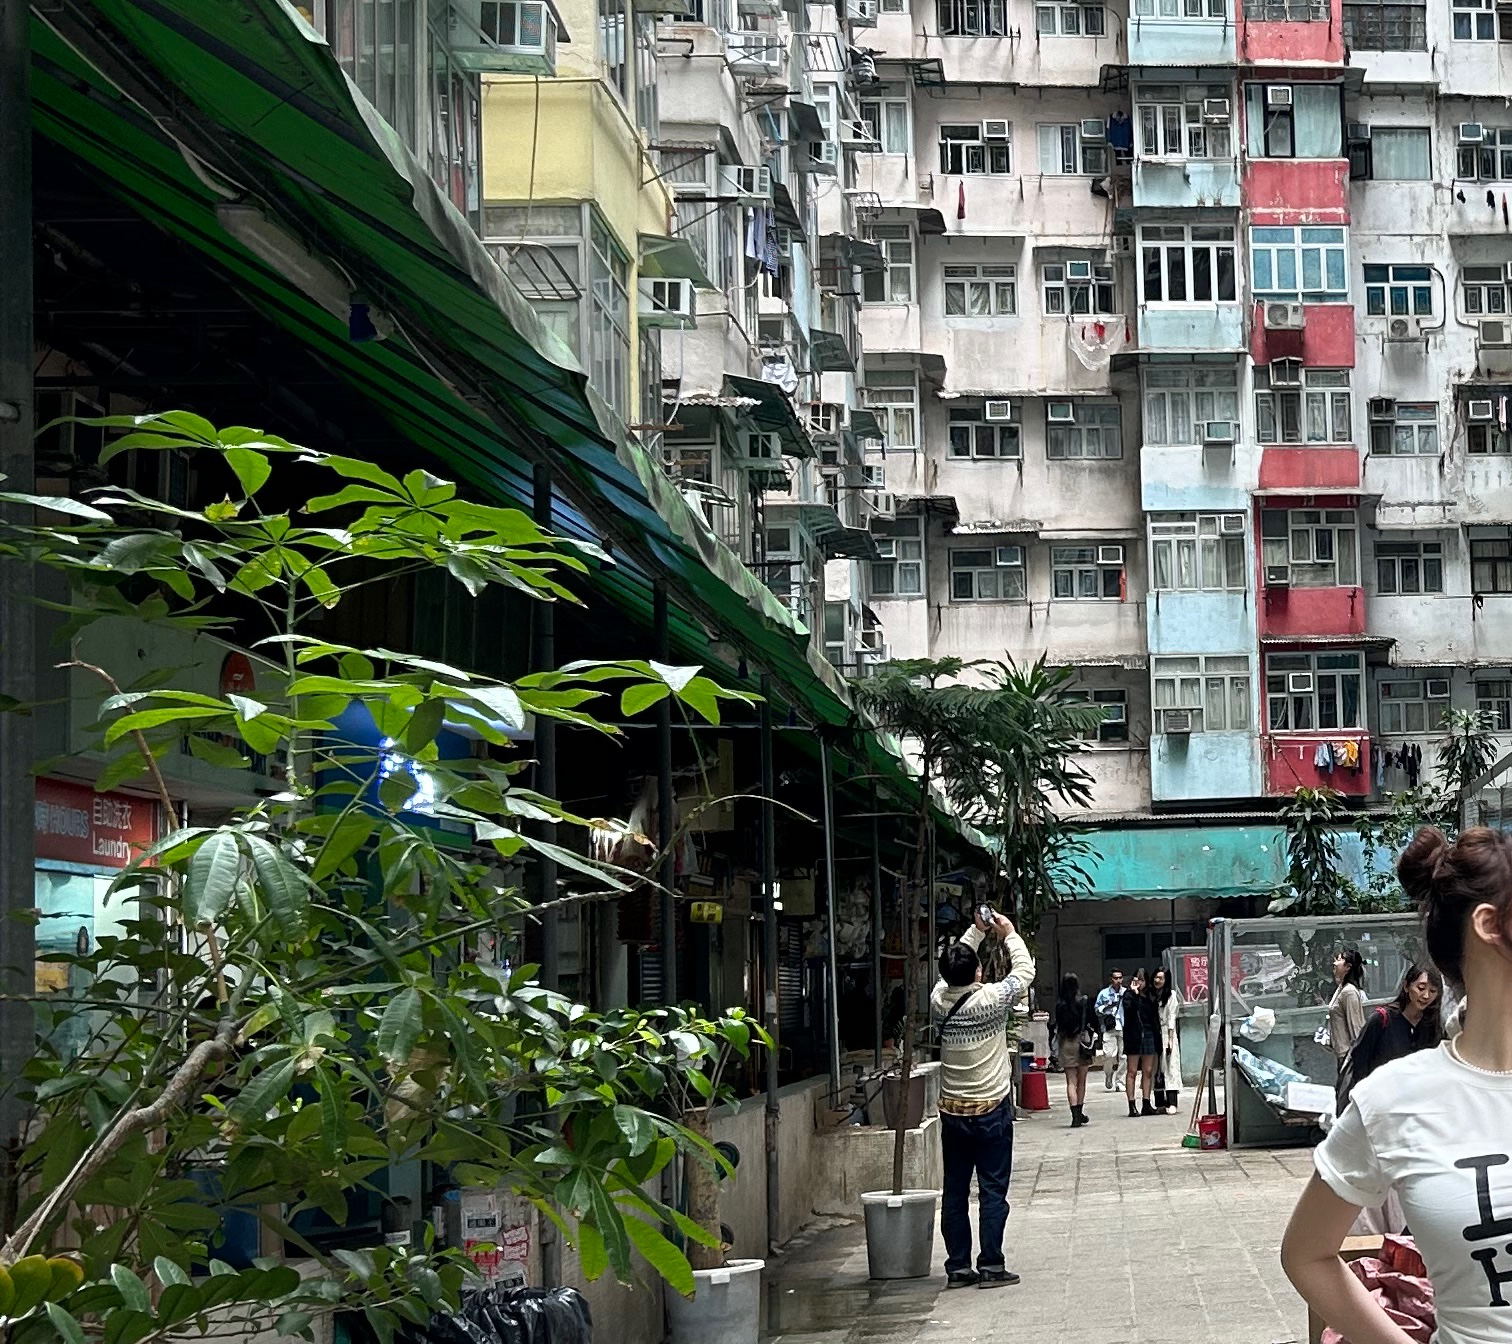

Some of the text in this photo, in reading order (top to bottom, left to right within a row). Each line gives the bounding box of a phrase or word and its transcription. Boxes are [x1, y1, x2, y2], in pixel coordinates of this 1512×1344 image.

[92, 797, 132, 831] 自助洗衣
[92, 830, 132, 867] Laundry
